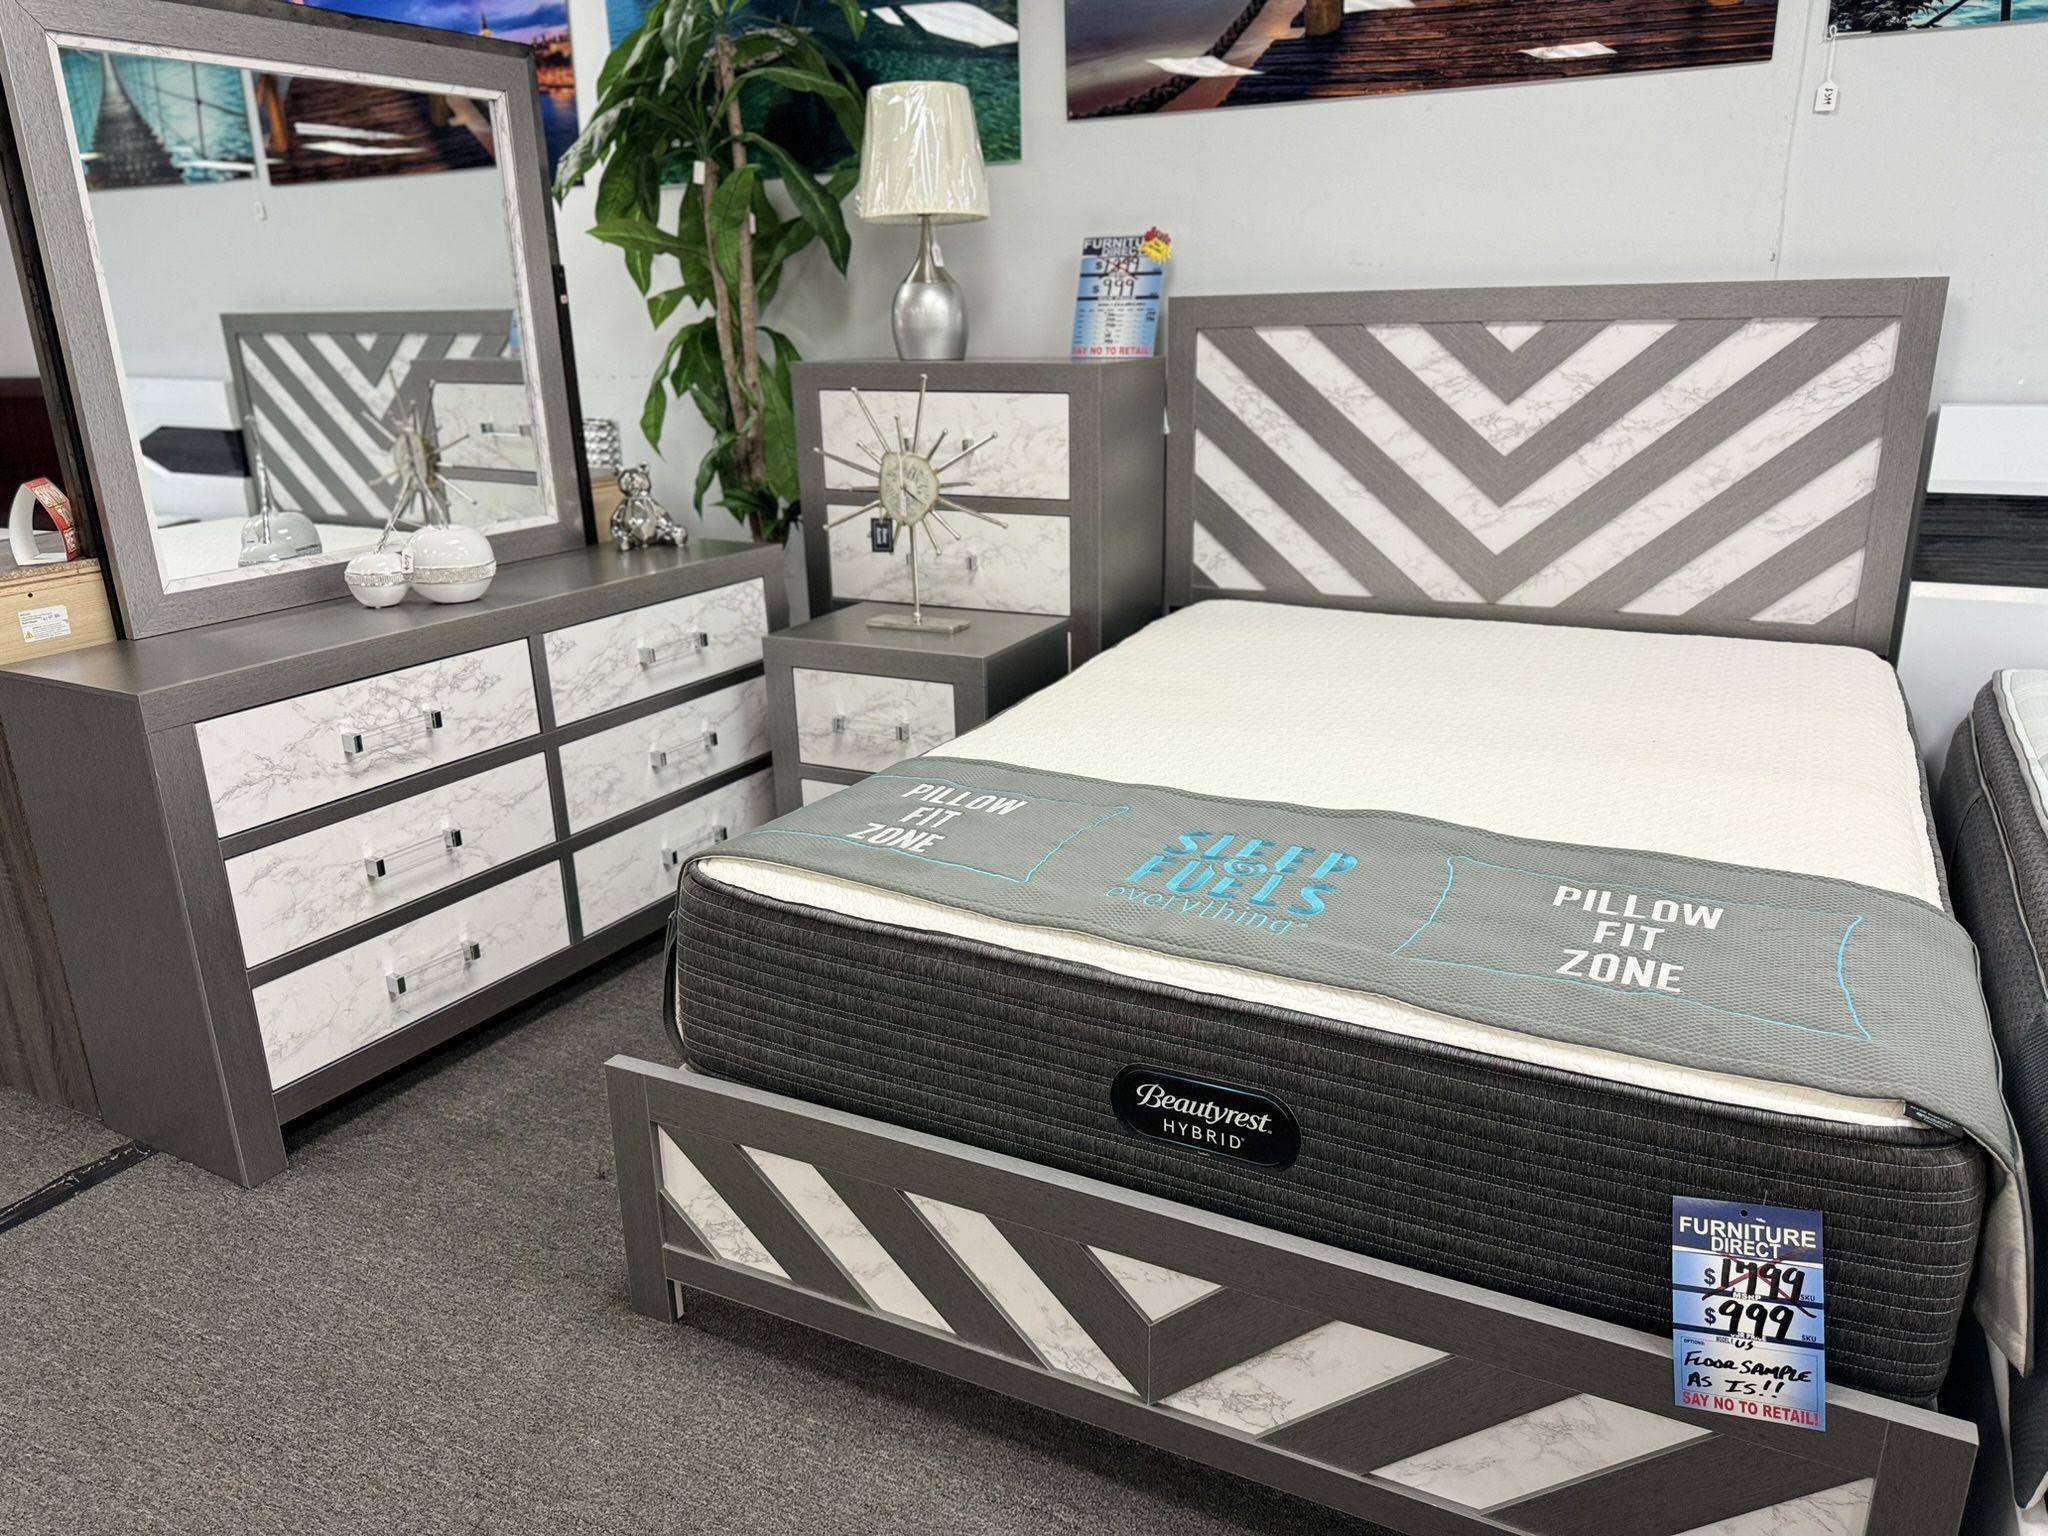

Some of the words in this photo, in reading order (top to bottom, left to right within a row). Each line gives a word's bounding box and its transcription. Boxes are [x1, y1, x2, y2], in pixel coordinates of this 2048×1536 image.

[1083, 237, 1143, 249] FURNITU
[1102, 247, 1138, 257] DIREC
[1090, 346, 1103, 355] NO
[1106, 346, 1117, 355] TO
[901, 783, 1028, 815] PILLOW
[900, 806, 963, 828] FIT
[846, 822, 946, 852] ZONE
[1163, 831, 1359, 880] SLEEP
[1125, 854, 1336, 917] FUELS
[1106, 886, 1293, 935] everything
[1552, 885, 1724, 930] PILLOW
[1592, 920, 1666, 951] FIT
[1555, 949, 1684, 993] ZONE
[1136, 1083, 1272, 1135] Beautyrest
[1163, 1118, 1242, 1149] HYBRID
[1679, 1215, 1817, 1249] FURNITURE
[1711, 1236, 1781, 1259] DIRECT
[1800, 1293, 1816, 1301] SKU
[1801, 1334, 1817, 1342] SKU
[1687, 1371, 1713, 1387] AS
[1739, 1360, 1813, 1382] SAMPLE
[1682, 1391, 1709, 1407] SAY
[1714, 1396, 1734, 1411] NO
[1739, 1400, 1758, 1415] TO
[1763, 1404, 1820, 1426] RETAIL!
